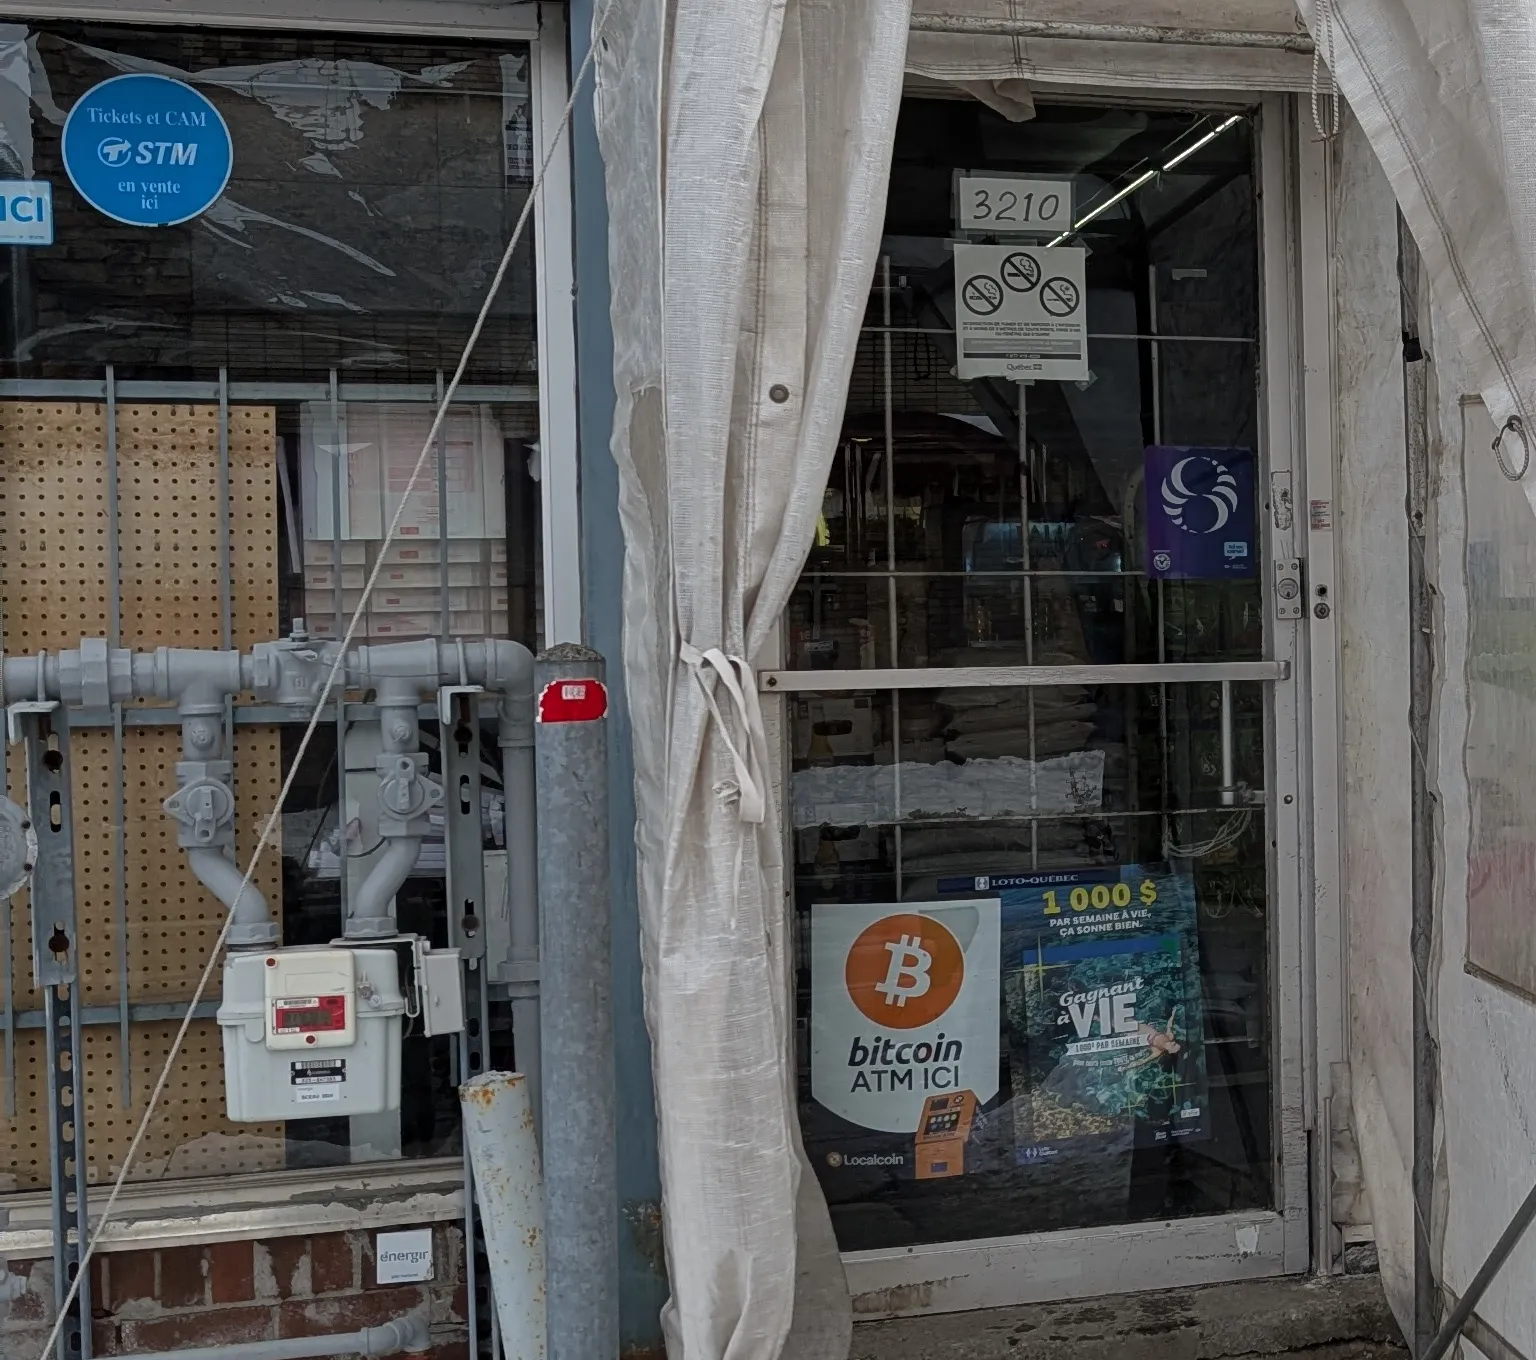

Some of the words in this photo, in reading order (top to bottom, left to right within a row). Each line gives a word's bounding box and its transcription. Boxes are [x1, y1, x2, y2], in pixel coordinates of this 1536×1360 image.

[87, 107, 142, 124] Tickets
[147, 113, 160, 125] et
[165, 111, 207, 127] CAM
[135, 141, 198, 166] STM
[118, 181, 135, 193] en
[140, 180, 181, 194] vente
[141, 194, 159, 209] ici
[973, 189, 1060, 222] 3210
[991, 874, 1079, 887] LOTO-QUÉBEC
[1042, 890, 1061, 916] 1
[1069, 883, 1131, 913] 000
[1139, 878, 1157, 906] $
[1049, 916, 1071, 928] PAR
[1072, 911, 1120, 926] SEMAINE
[1121, 909, 1130, 920] À
[1130, 908, 1152, 920] VIE,
[1059, 926, 1075, 937] ÇA
[1076, 922, 1113, 935] SONNE
[1114, 919, 1144, 931] BIEN.
[1059, 976, 1145, 1008] Gagnant
[1057, 1010, 1070, 1026] à
[1067, 992, 1140, 1039] VIE
[848, 1033, 963, 1068] bitcoin
[850, 1070, 914, 1093] ATM
[924, 1066, 960, 1090] ICI
[843, 1152, 904, 1167] Localcoin
